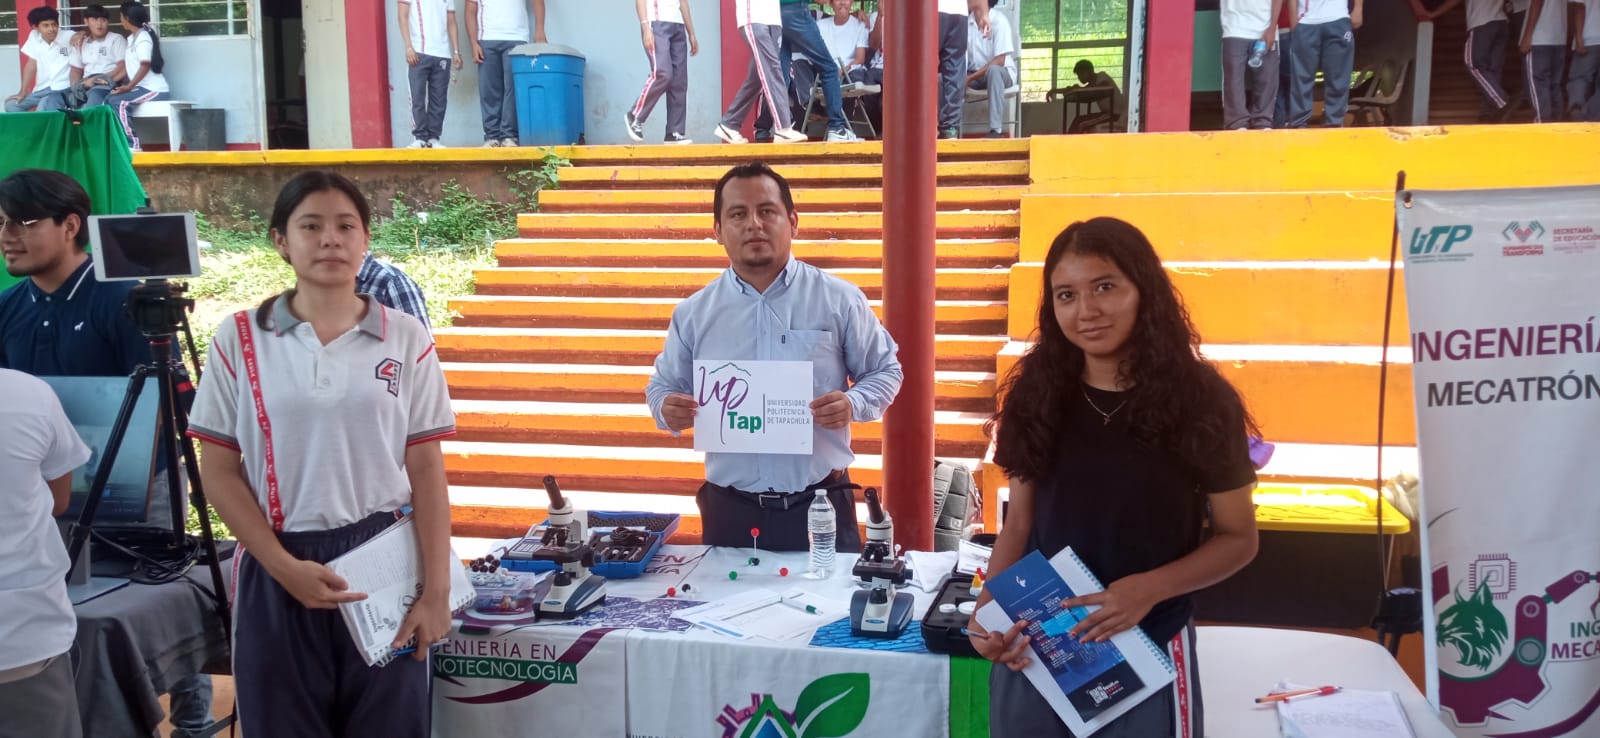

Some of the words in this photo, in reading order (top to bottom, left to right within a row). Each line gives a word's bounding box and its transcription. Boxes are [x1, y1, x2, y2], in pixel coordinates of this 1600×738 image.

[1412, 316, 1600, 364] INGENIERÍ
[727, 412, 762, 433] Tap
[776, 416, 810, 425] TAPACHULA
[434, 639, 522, 658] ENIERÍA
[531, 644, 556, 660] EN
